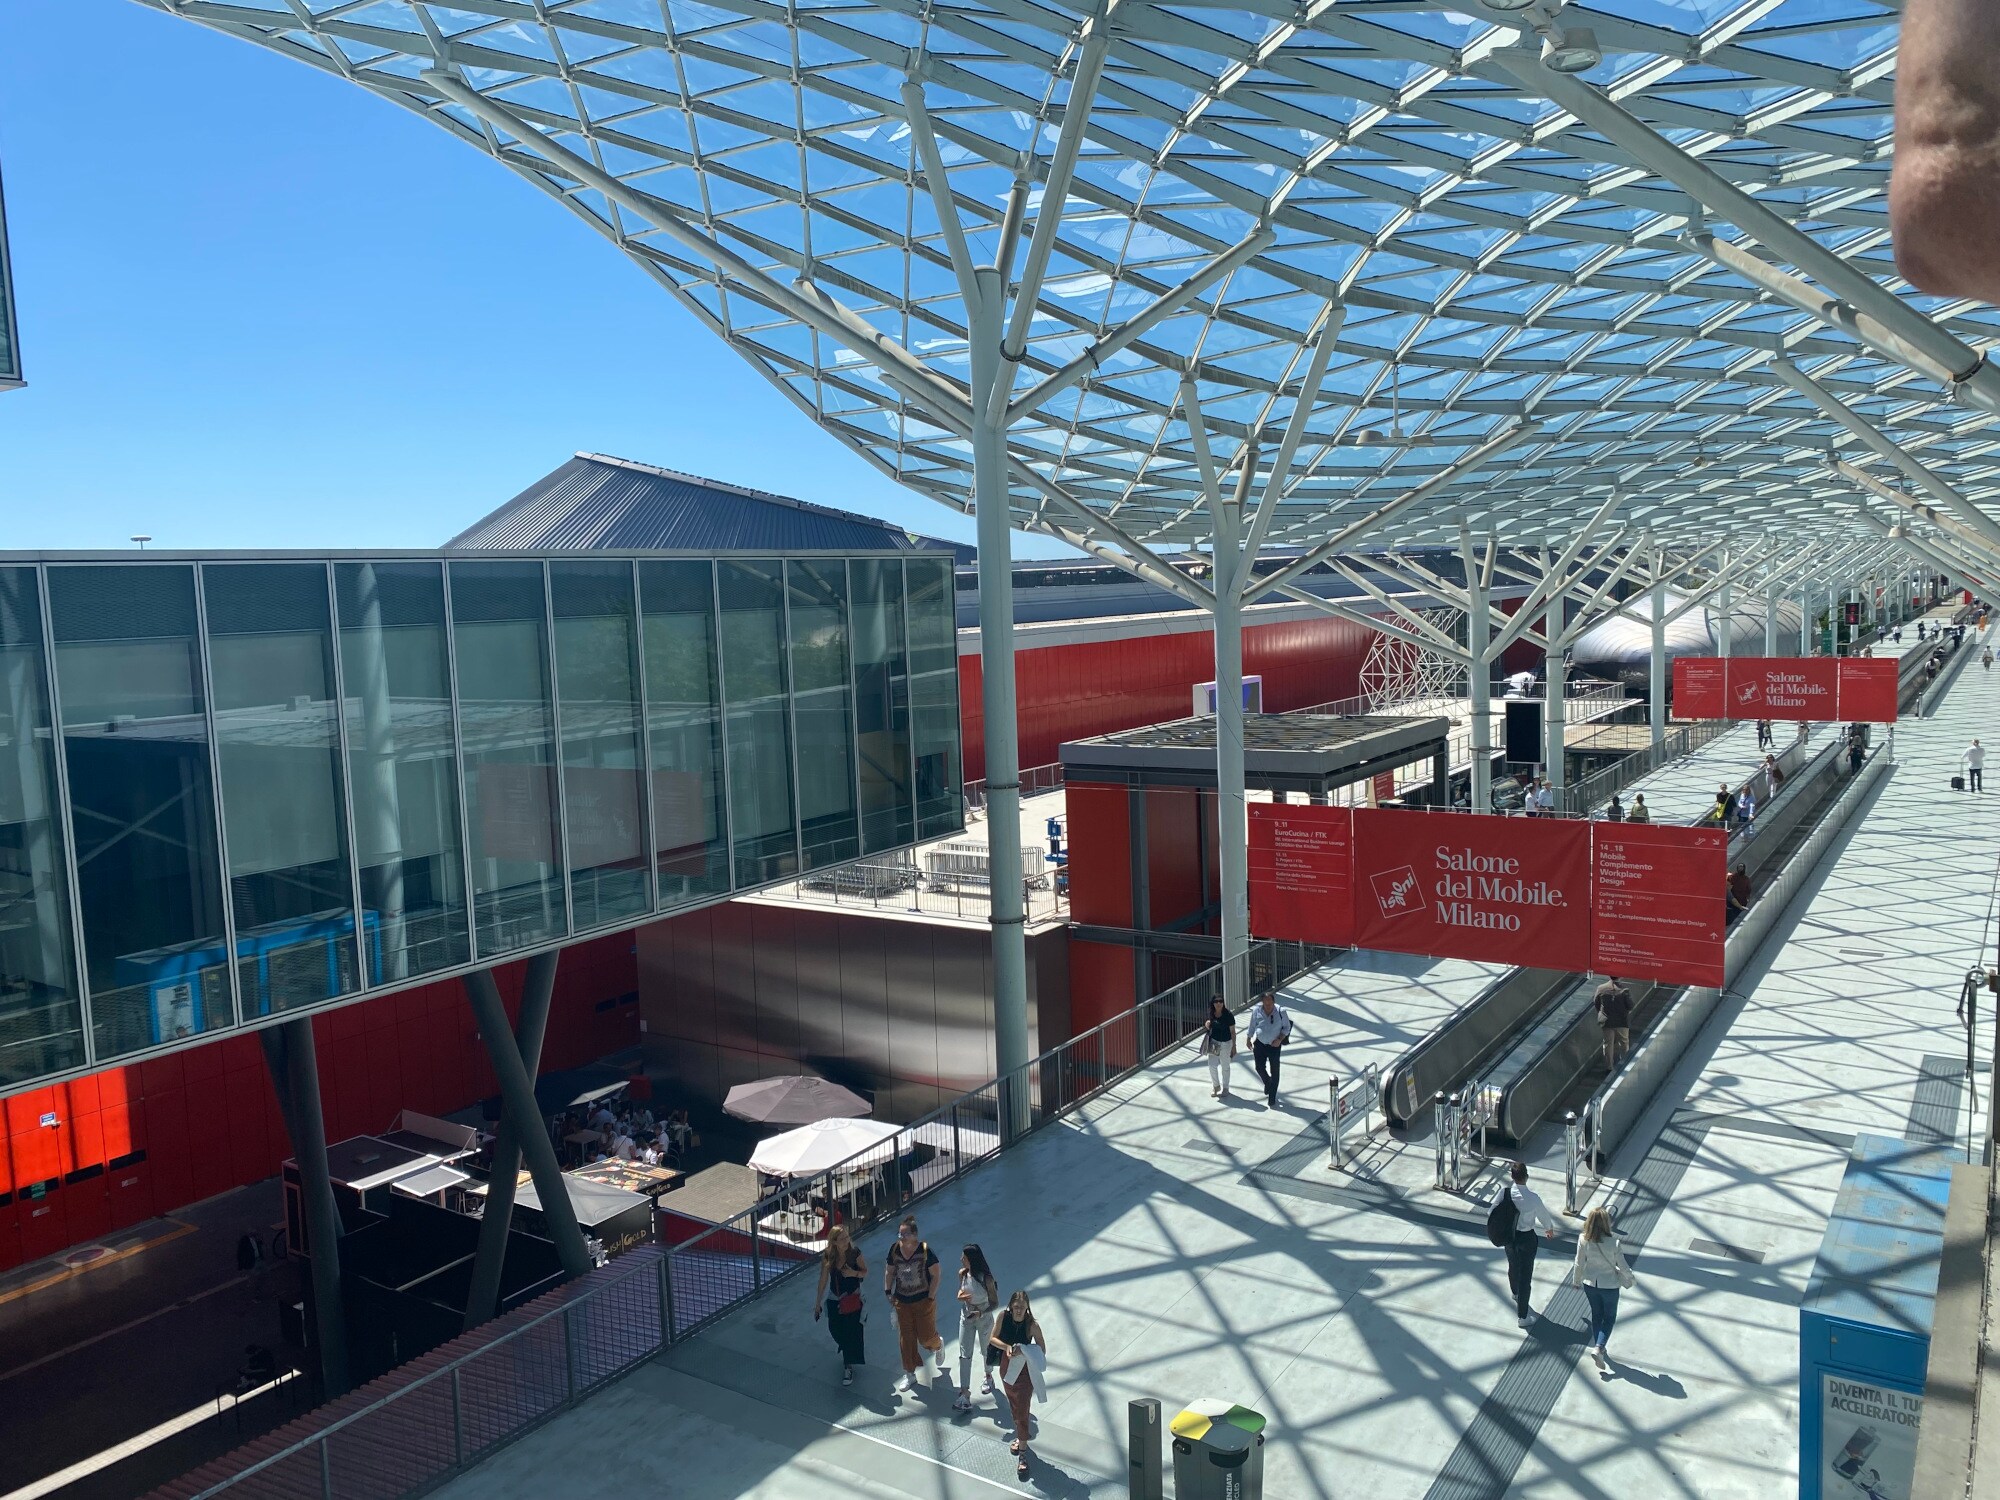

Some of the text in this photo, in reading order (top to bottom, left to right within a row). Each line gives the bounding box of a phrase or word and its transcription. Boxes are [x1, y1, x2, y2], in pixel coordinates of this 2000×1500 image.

[1766, 671, 1806, 683] Salone
[1766, 683, 1828, 695] del Mobile.
[1766, 695, 1807, 707] Milano
[1275, 829, 1309, 838] EuroCucina
[1315, 831, 1327, 839] FTK
[1435, 846, 1519, 875] Salone
[1600, 852, 1626, 861] Mobile
[1600, 860, 1653, 871] Complemento
[1600, 868, 1642, 879] Workplace
[1600, 876, 1625, 886] Design
[1435, 874, 1568, 907] del Mobile.
[1435, 900, 1521, 932] Milano
[1618, 914, 1656, 922] Complemento
[1657, 917, 1686, 925] Workplace
[1687, 920, 1707, 928] Design
[1829, 1380, 1883, 1405] DIVENTA
[1887, 1393, 1898, 1408] IL
